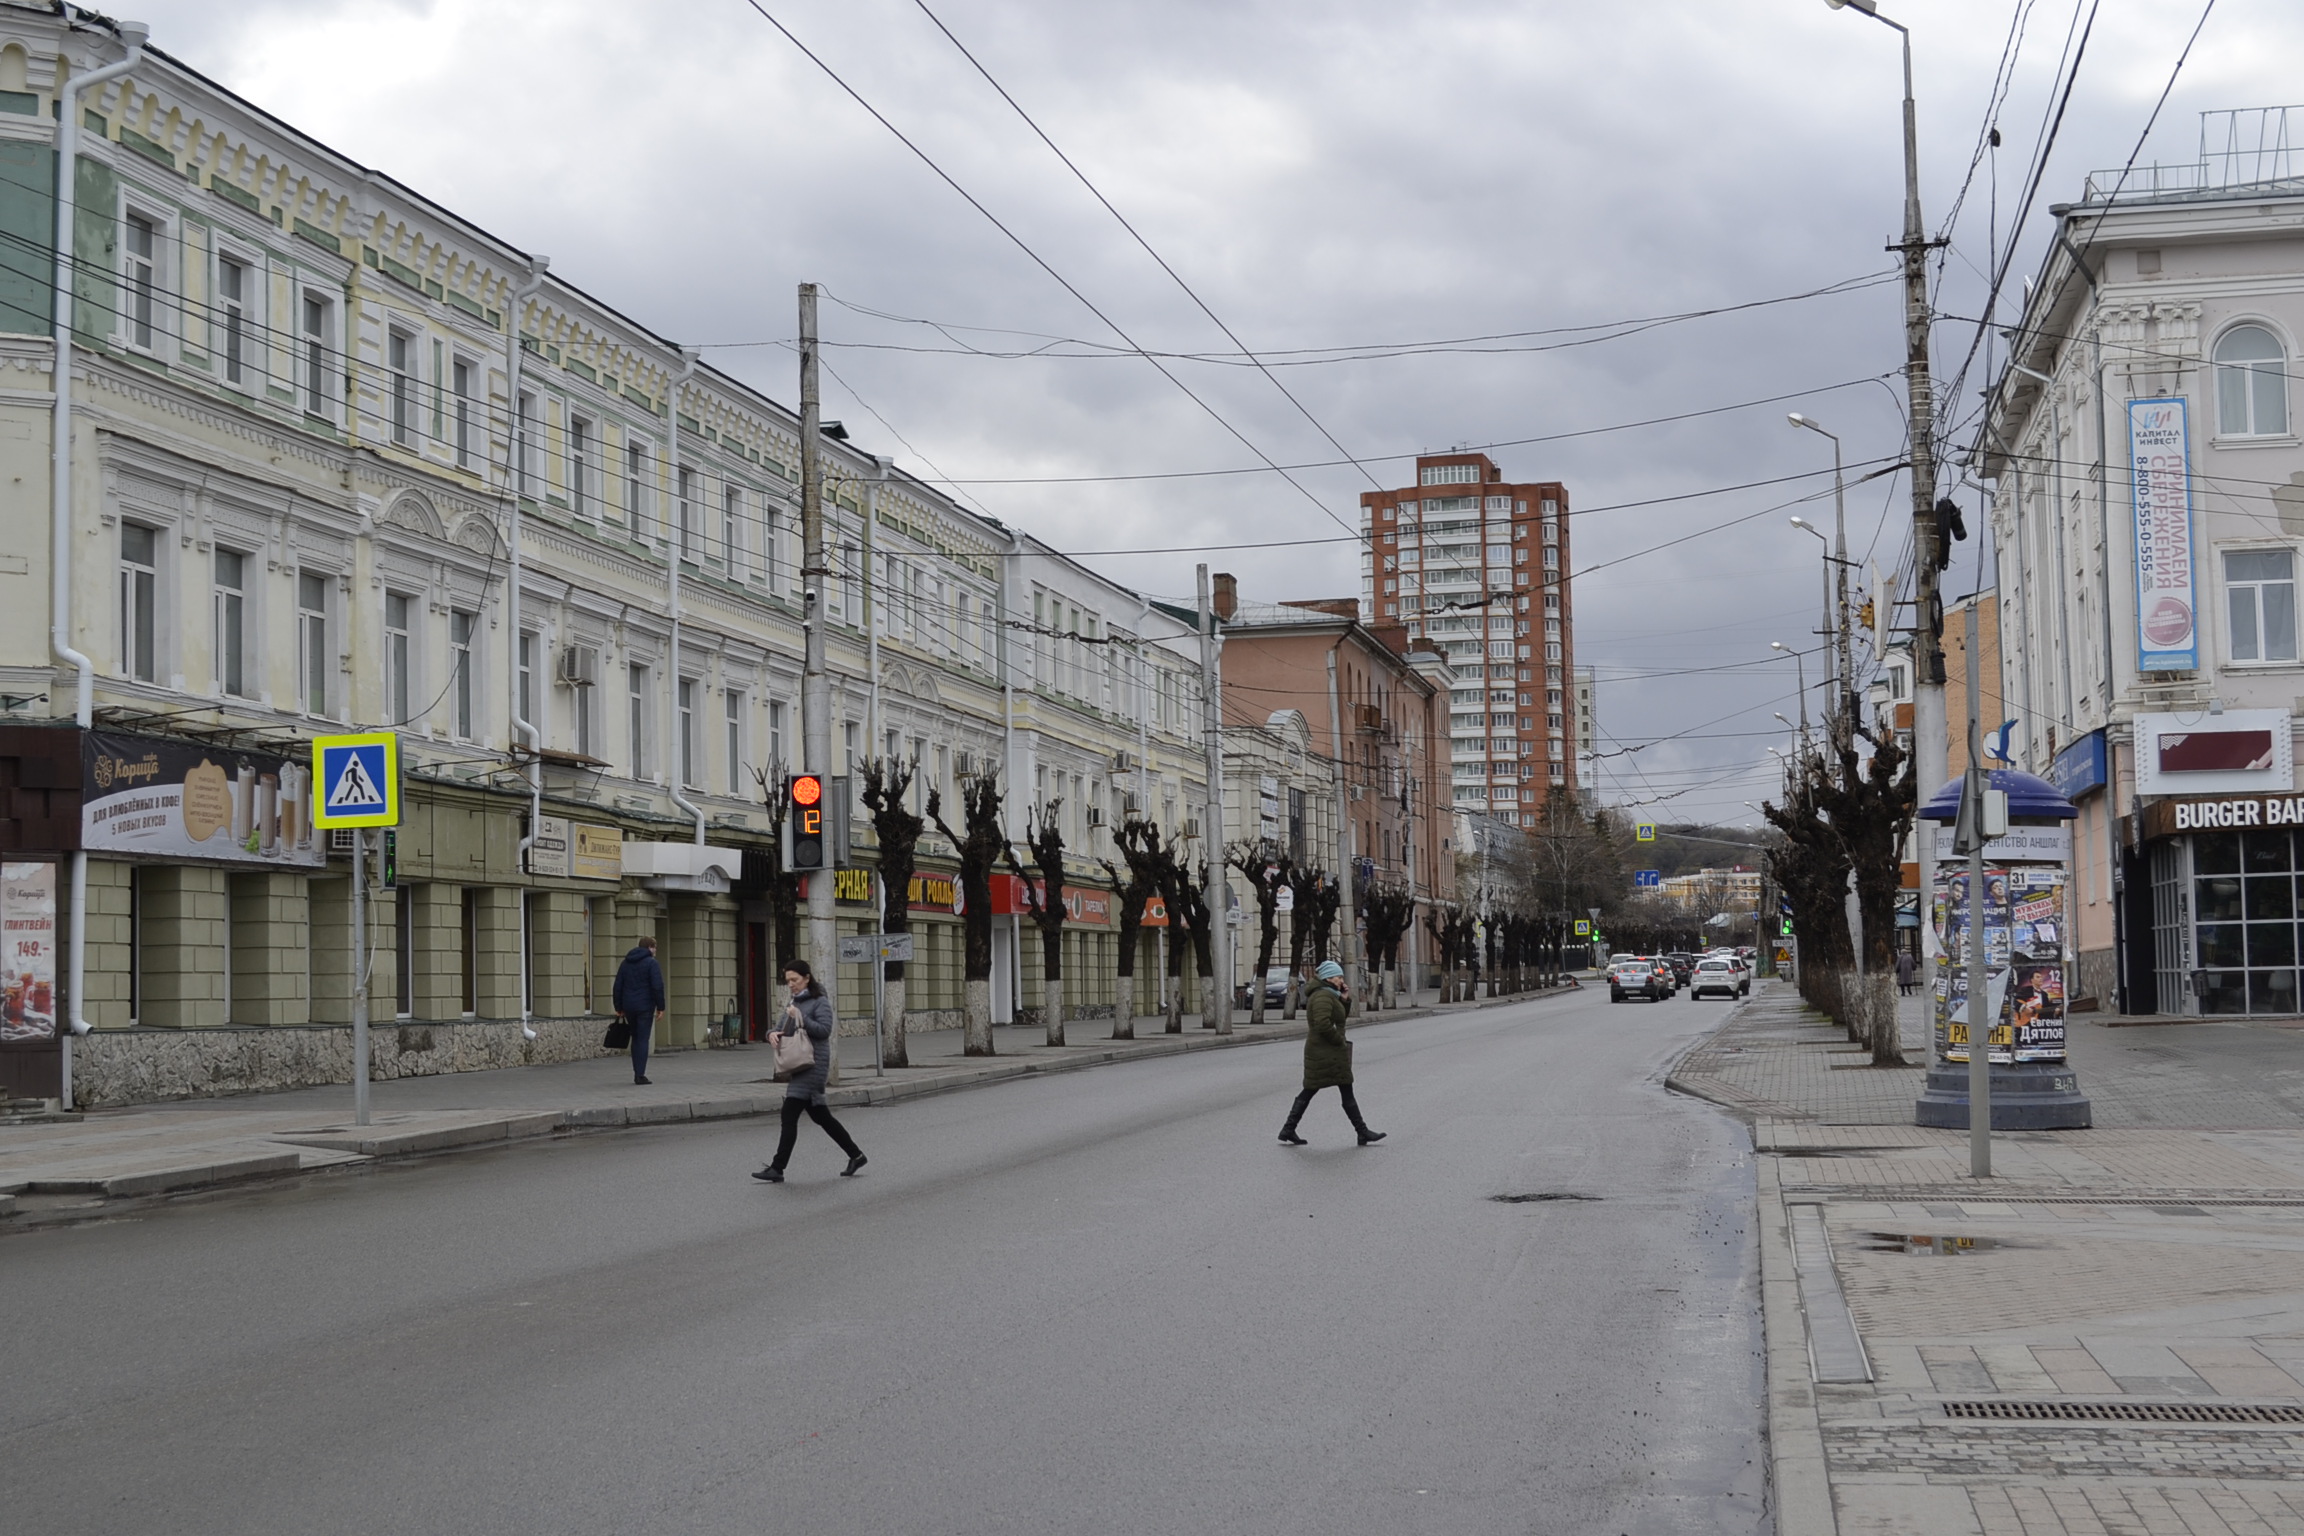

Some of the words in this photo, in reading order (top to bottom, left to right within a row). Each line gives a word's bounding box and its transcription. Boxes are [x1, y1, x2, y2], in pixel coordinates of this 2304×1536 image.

[2136, 430, 2181, 438] КАПИТАЛ
[2139, 438, 2177, 446] ИНВЕСТ
[2136, 456, 2153, 571] 8-800-555-0-555
[2150, 455, 2172, 589] СБЕРЕЖЕНИЯ
[2166, 455, 2189, 589] ПРИНИМАЕМ
[114, 758, 160, 785] Корица
[93, 808, 107, 825] ДЛЯ
[108, 797, 155, 819] ВЛЮБЛЁННЫХ
[155, 796, 160, 809] В
[161, 795, 180, 808] КОФЕ!
[804, 809, 820, 834] 12
[2175, 801, 2261, 829] BURGER
[111, 823, 117, 836] 5
[117, 818, 141, 834] НОВЫХ
[142, 814, 167, 829] ВКУСОВ
[2012, 872, 2025, 884] 31
[17, 889, 46, 900] Корица
[926, 879, 957, 905] РОЛЛЫ
[4, 917, 53, 931] ГЛИНТВЕЙН
[2049, 969, 2060, 982] 12
[2030, 1016, 2063, 1027] Евгений
